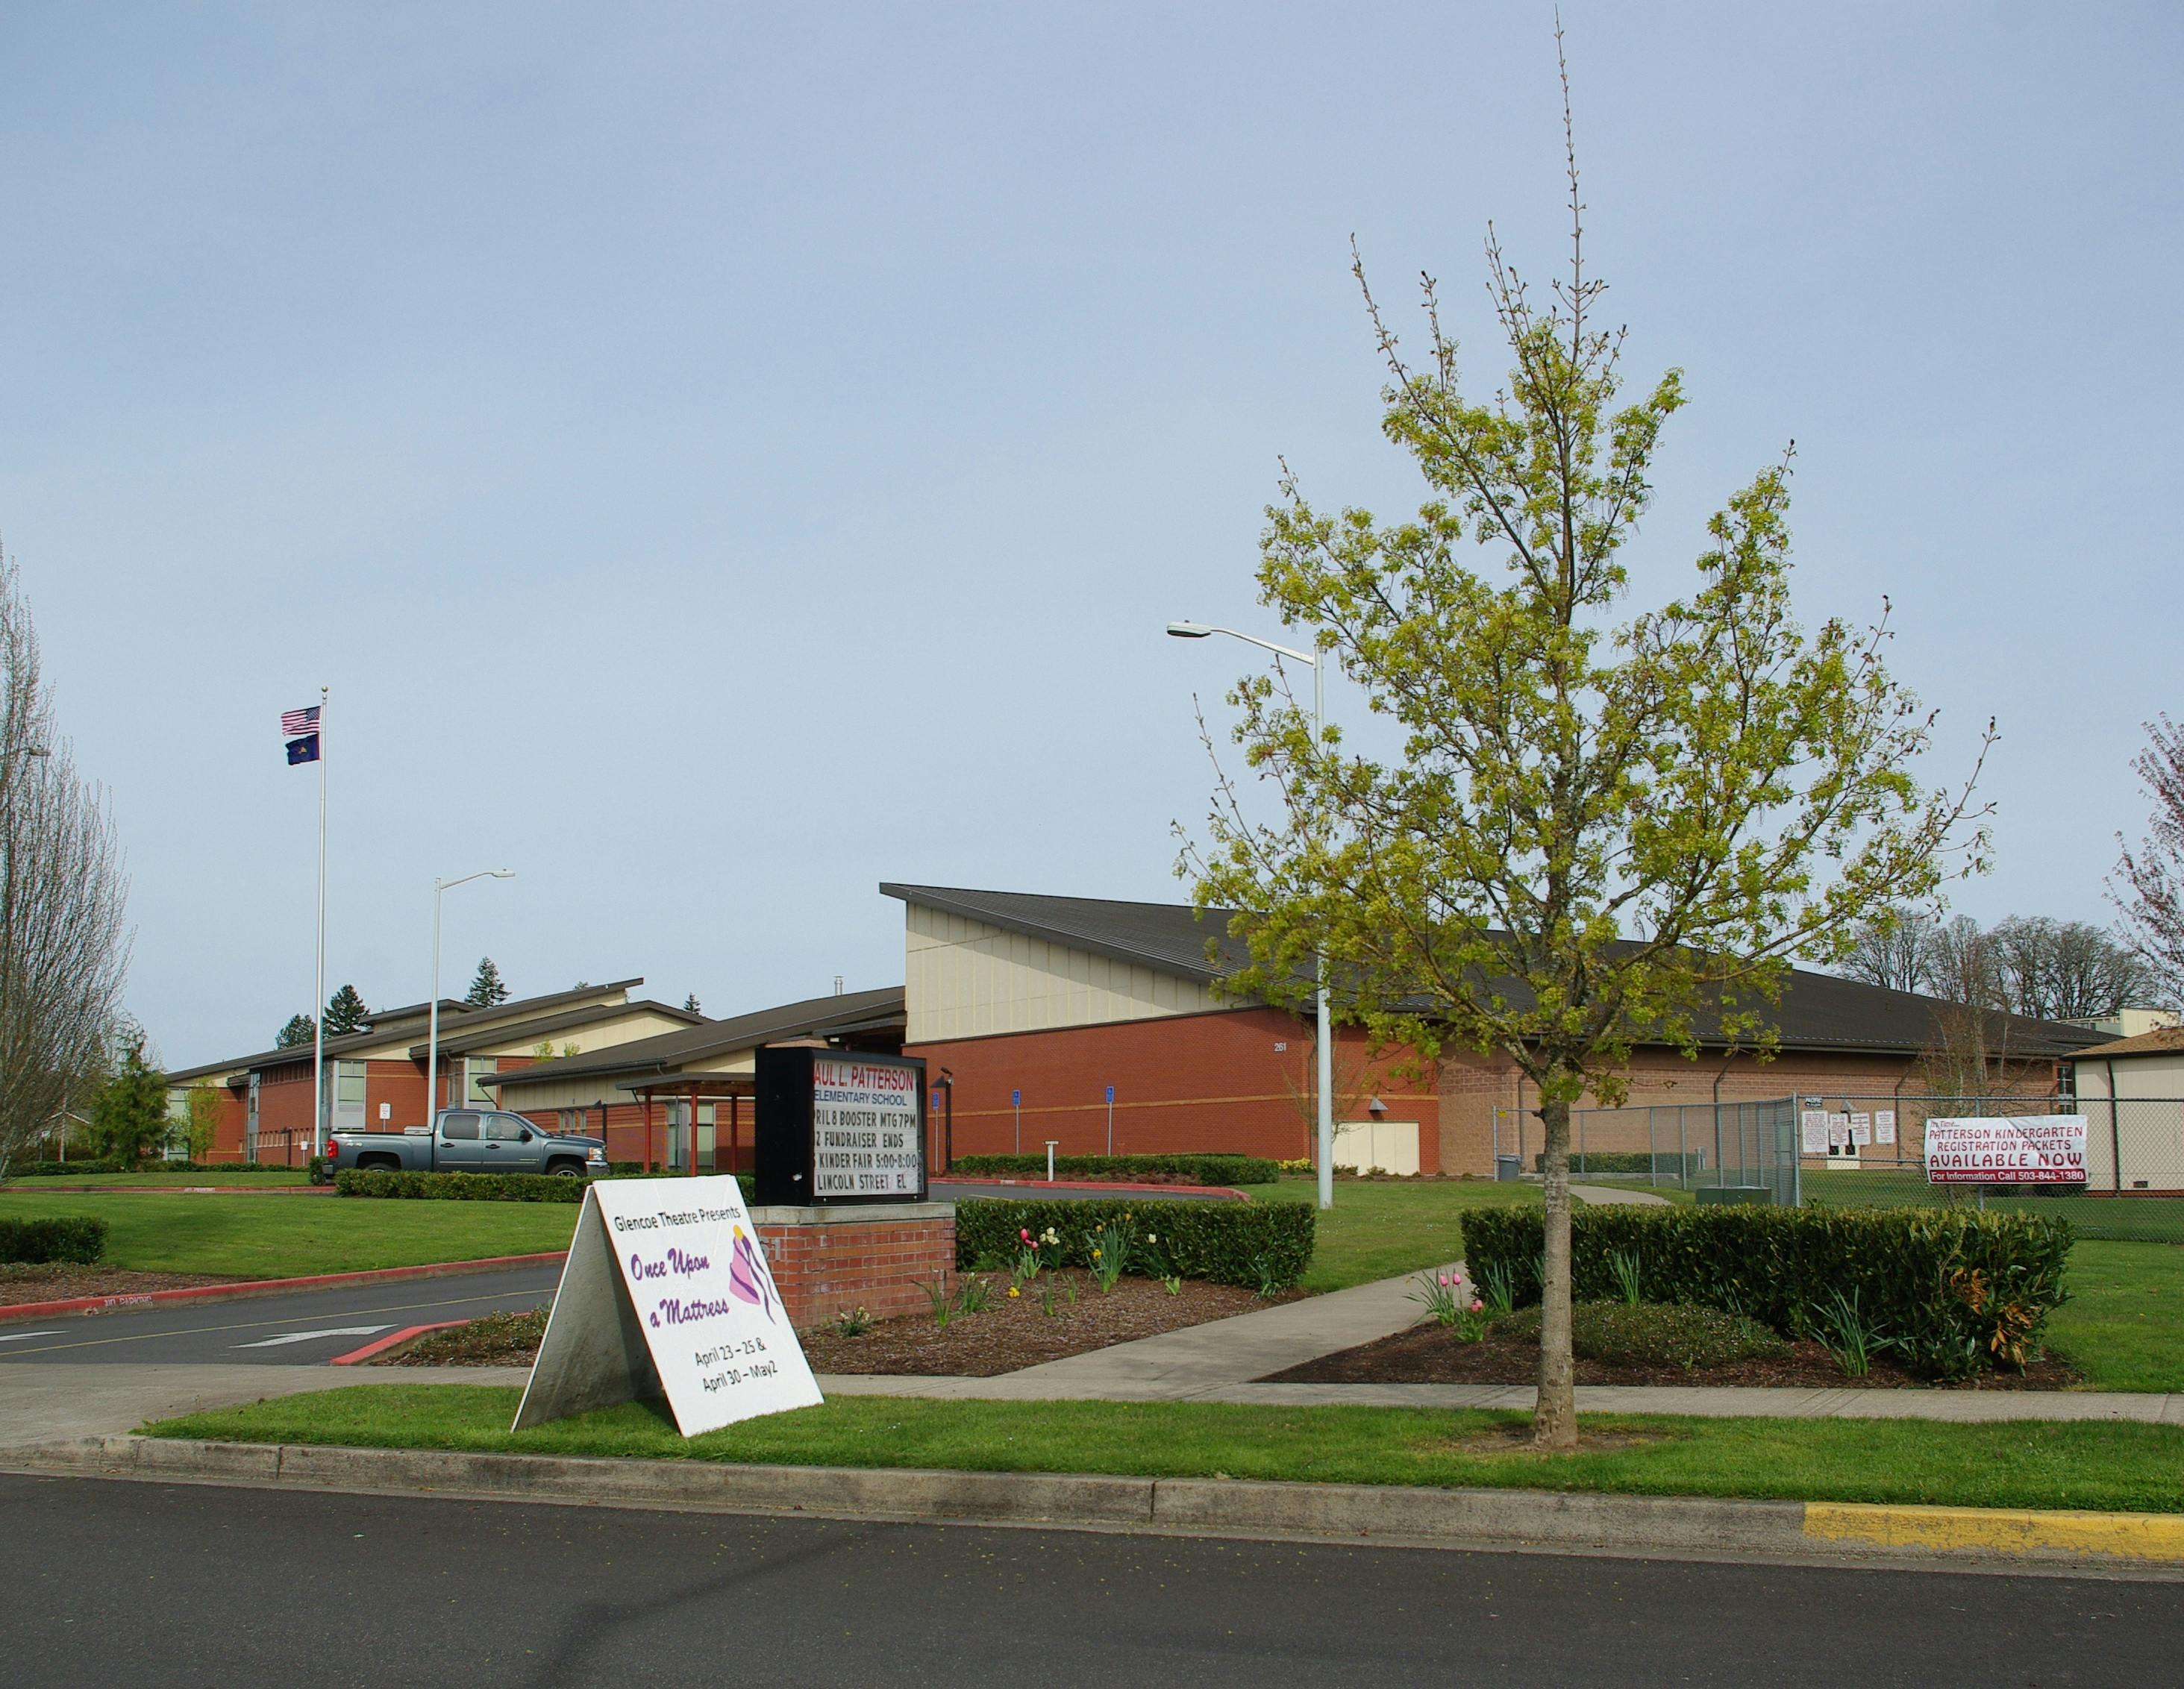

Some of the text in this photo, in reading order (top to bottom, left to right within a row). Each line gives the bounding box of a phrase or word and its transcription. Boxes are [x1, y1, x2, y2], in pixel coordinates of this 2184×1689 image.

[1274, 1042, 1286, 1051] 261
[851, 1065, 914, 1091] PATTERSON
[813, 1090, 907, 1106] ELEMENTARY SCHOOL
[814, 1109, 916, 1128] RIL 8 BOOSTER MTG 7PM
[825, 1132, 877, 1147] FUNDRAISER
[883, 1133, 904, 1147] ENDS
[1929, 1126, 2083, 1140] PATTERSON KINDERGARTEN
[1937, 1140, 2071, 1152] REGISTRATION PACKETS
[819, 1153, 851, 1168] KINDER
[853, 1153, 872, 1168] FAIR
[876, 1153, 917, 1168] 5:00-8:00
[1930, 1153, 2082, 1168] AVAILABLE NOW
[818, 1173, 907, 1190] LINCOLN STREET EL
[1931, 1171, 2084, 1180] For Information Call 503-844-1380
[614, 1206, 741, 1232] Glencoe Theatre Presents
[631, 1247, 710, 1281] Once Upon
[650, 1298, 729, 1328] a Mattress
[695, 1347, 720, 1368] April
[719, 1345, 734, 1360] 23
[742, 1340, 756, 1355] 25
[755, 1337, 767, 1351] &
[703, 1370, 728, 1394] April
[727, 1369, 742, 1385] 30
